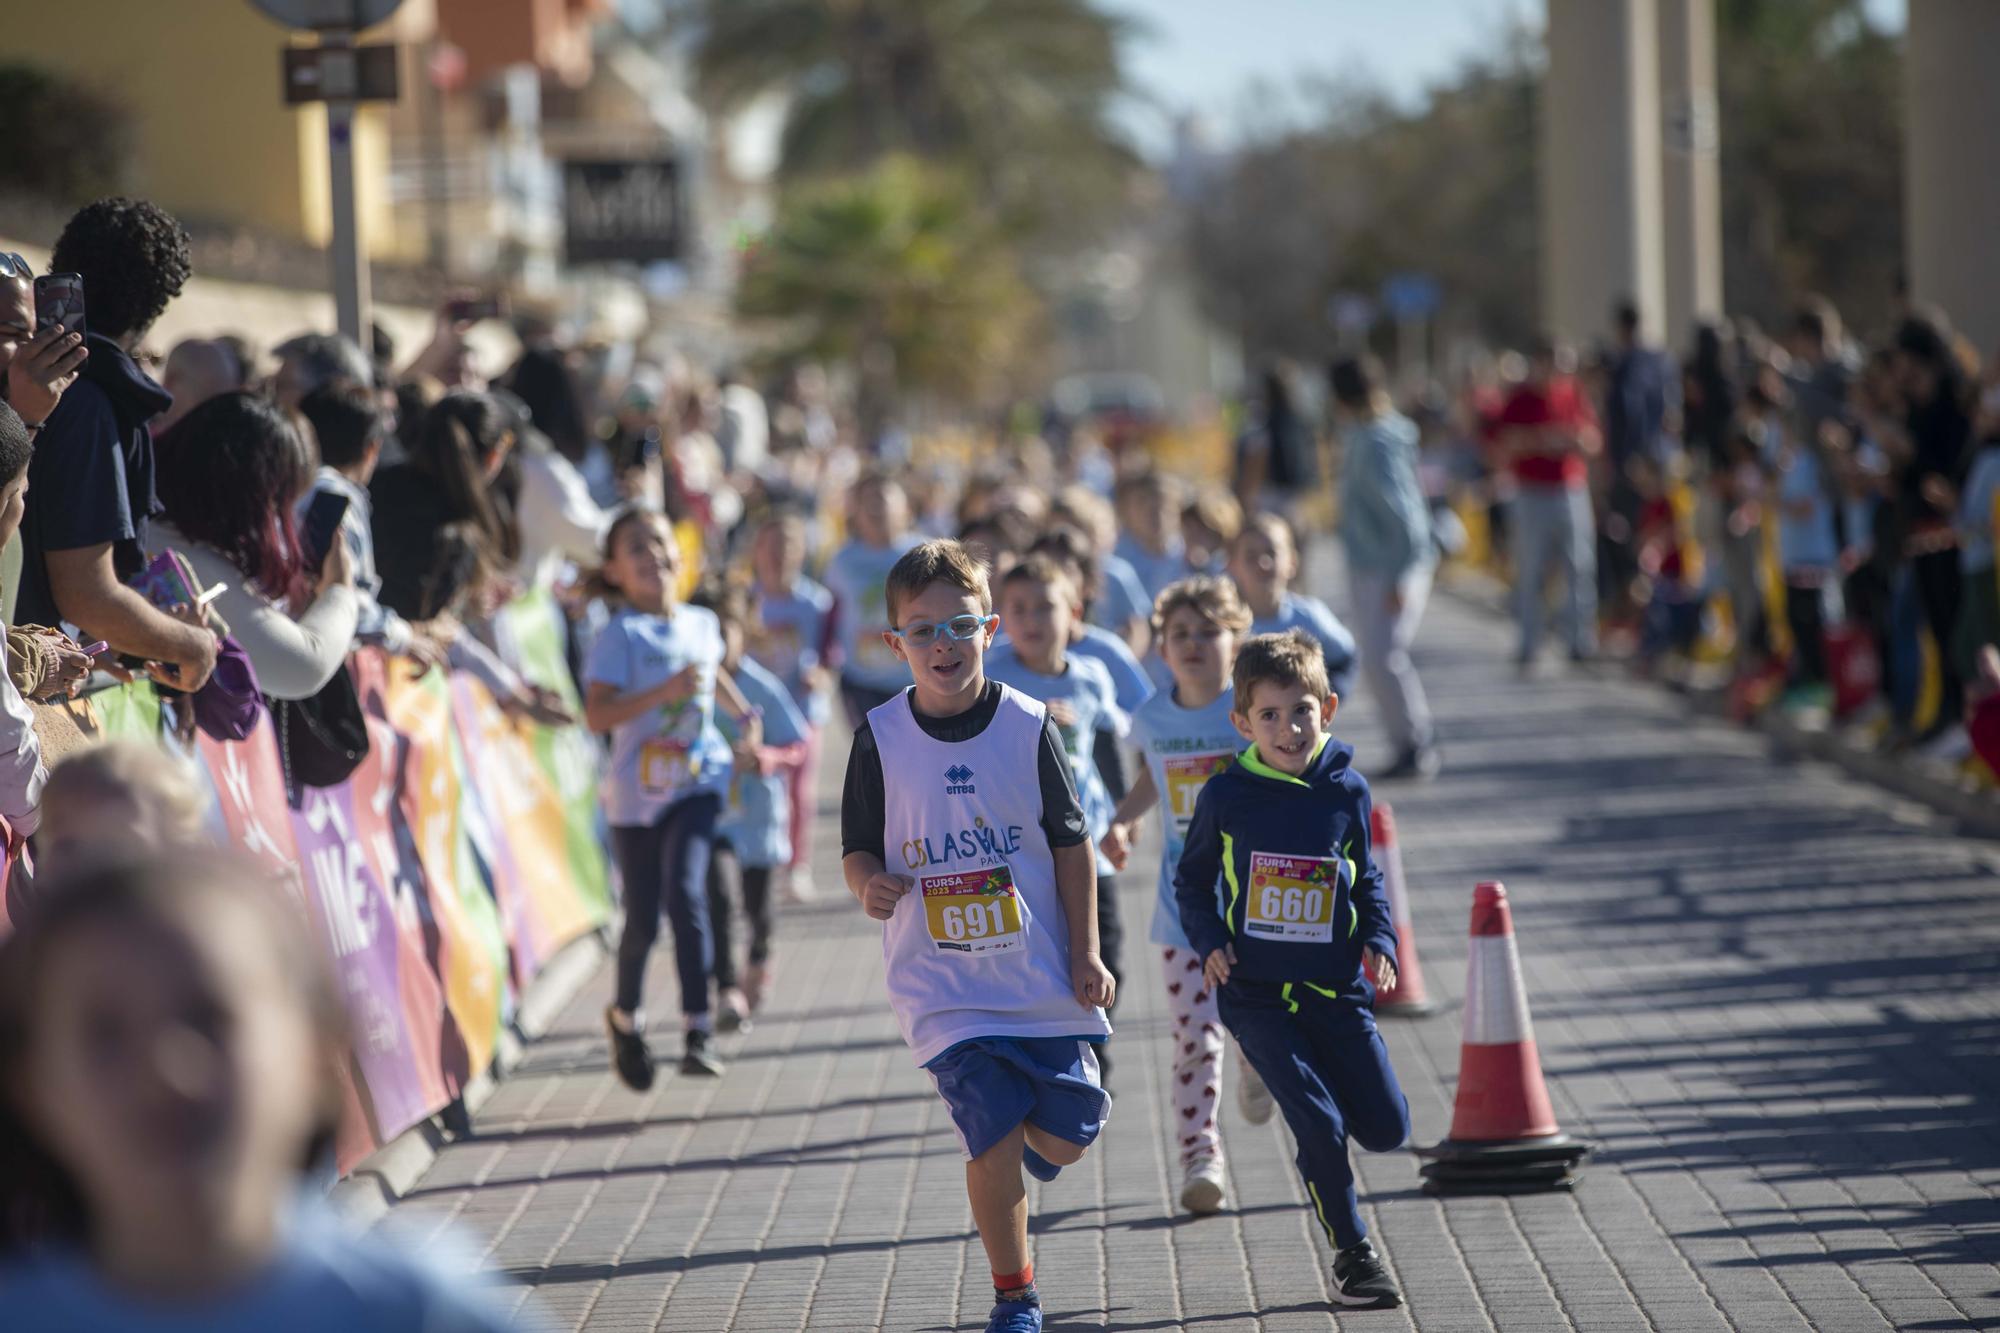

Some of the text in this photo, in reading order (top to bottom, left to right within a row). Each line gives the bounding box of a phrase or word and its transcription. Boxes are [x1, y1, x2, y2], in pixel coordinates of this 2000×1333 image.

[1256, 857, 1293, 869] CURSA
[925, 876, 963, 889] CURSA
[926, 887, 949, 897] 2023
[1260, 885, 1323, 922] 660
[942, 899, 1005, 940] 691
